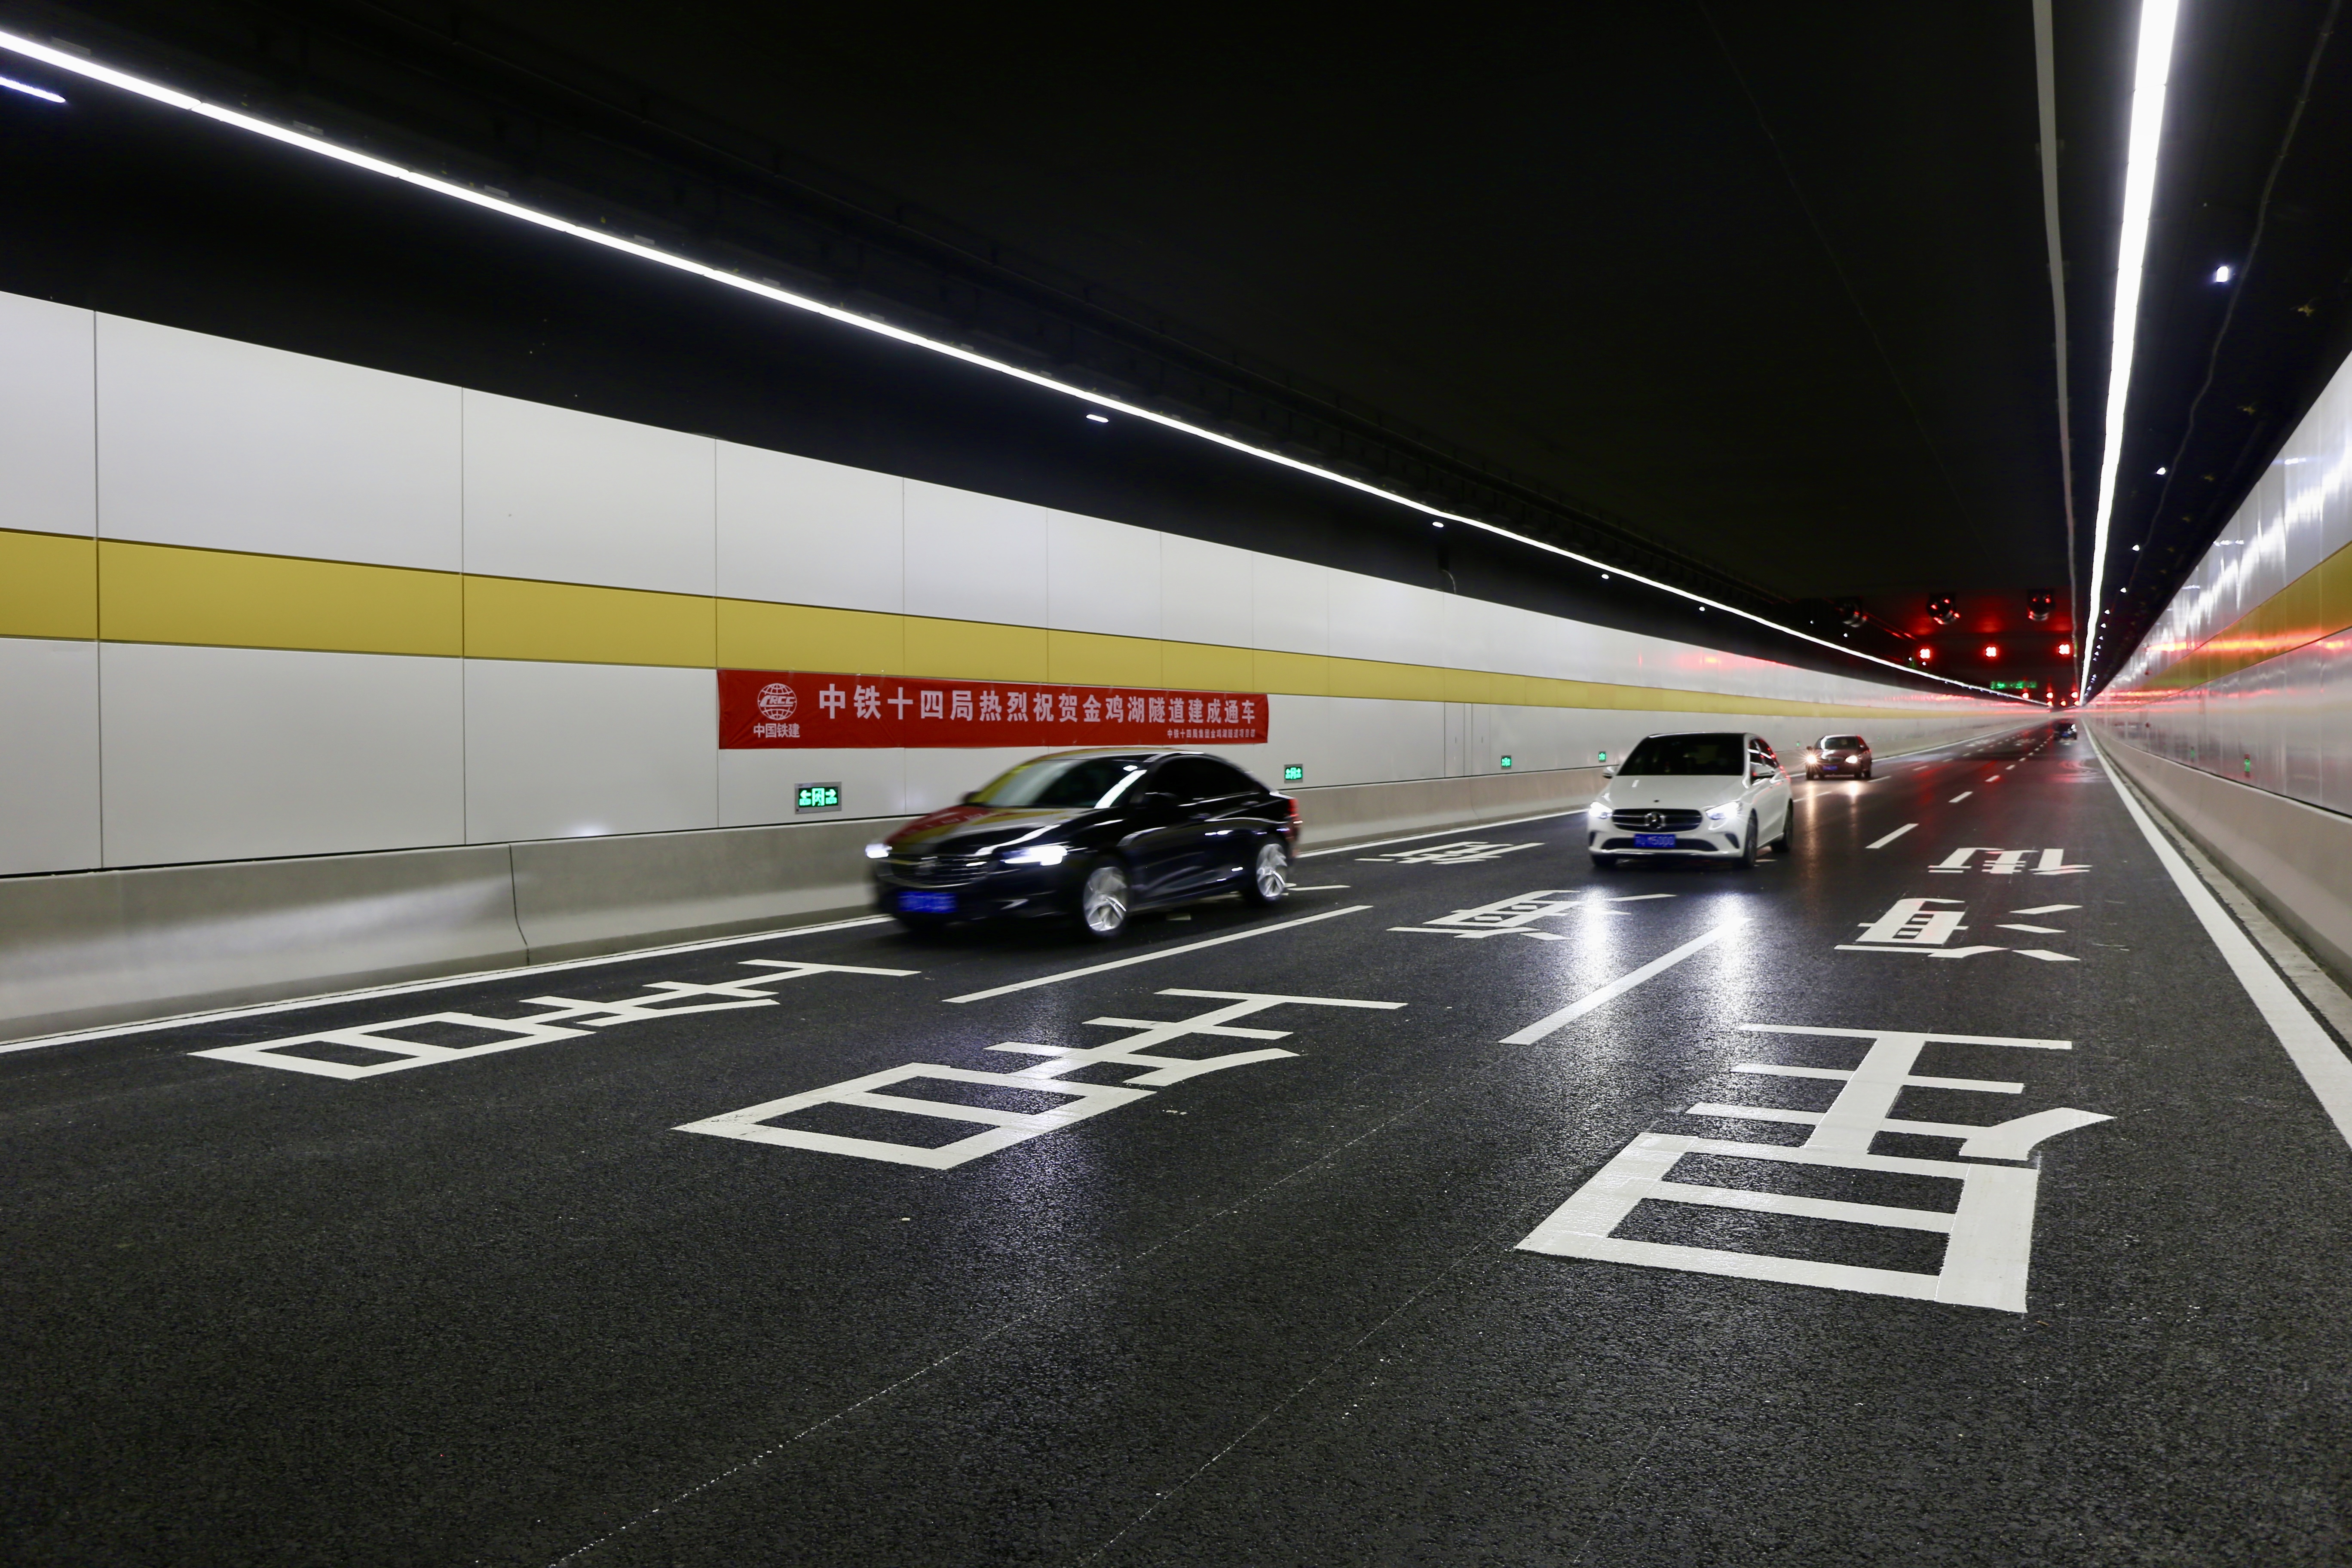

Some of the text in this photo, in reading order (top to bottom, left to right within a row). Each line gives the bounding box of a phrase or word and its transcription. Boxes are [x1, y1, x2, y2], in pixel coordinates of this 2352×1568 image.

[760, 695, 795, 707] CRCC
[819, 683, 1256, 725] 中铁十四局热烈祝贺金鸡湖隧道建成通车
[753, 723, 800, 738] 中国铁建
